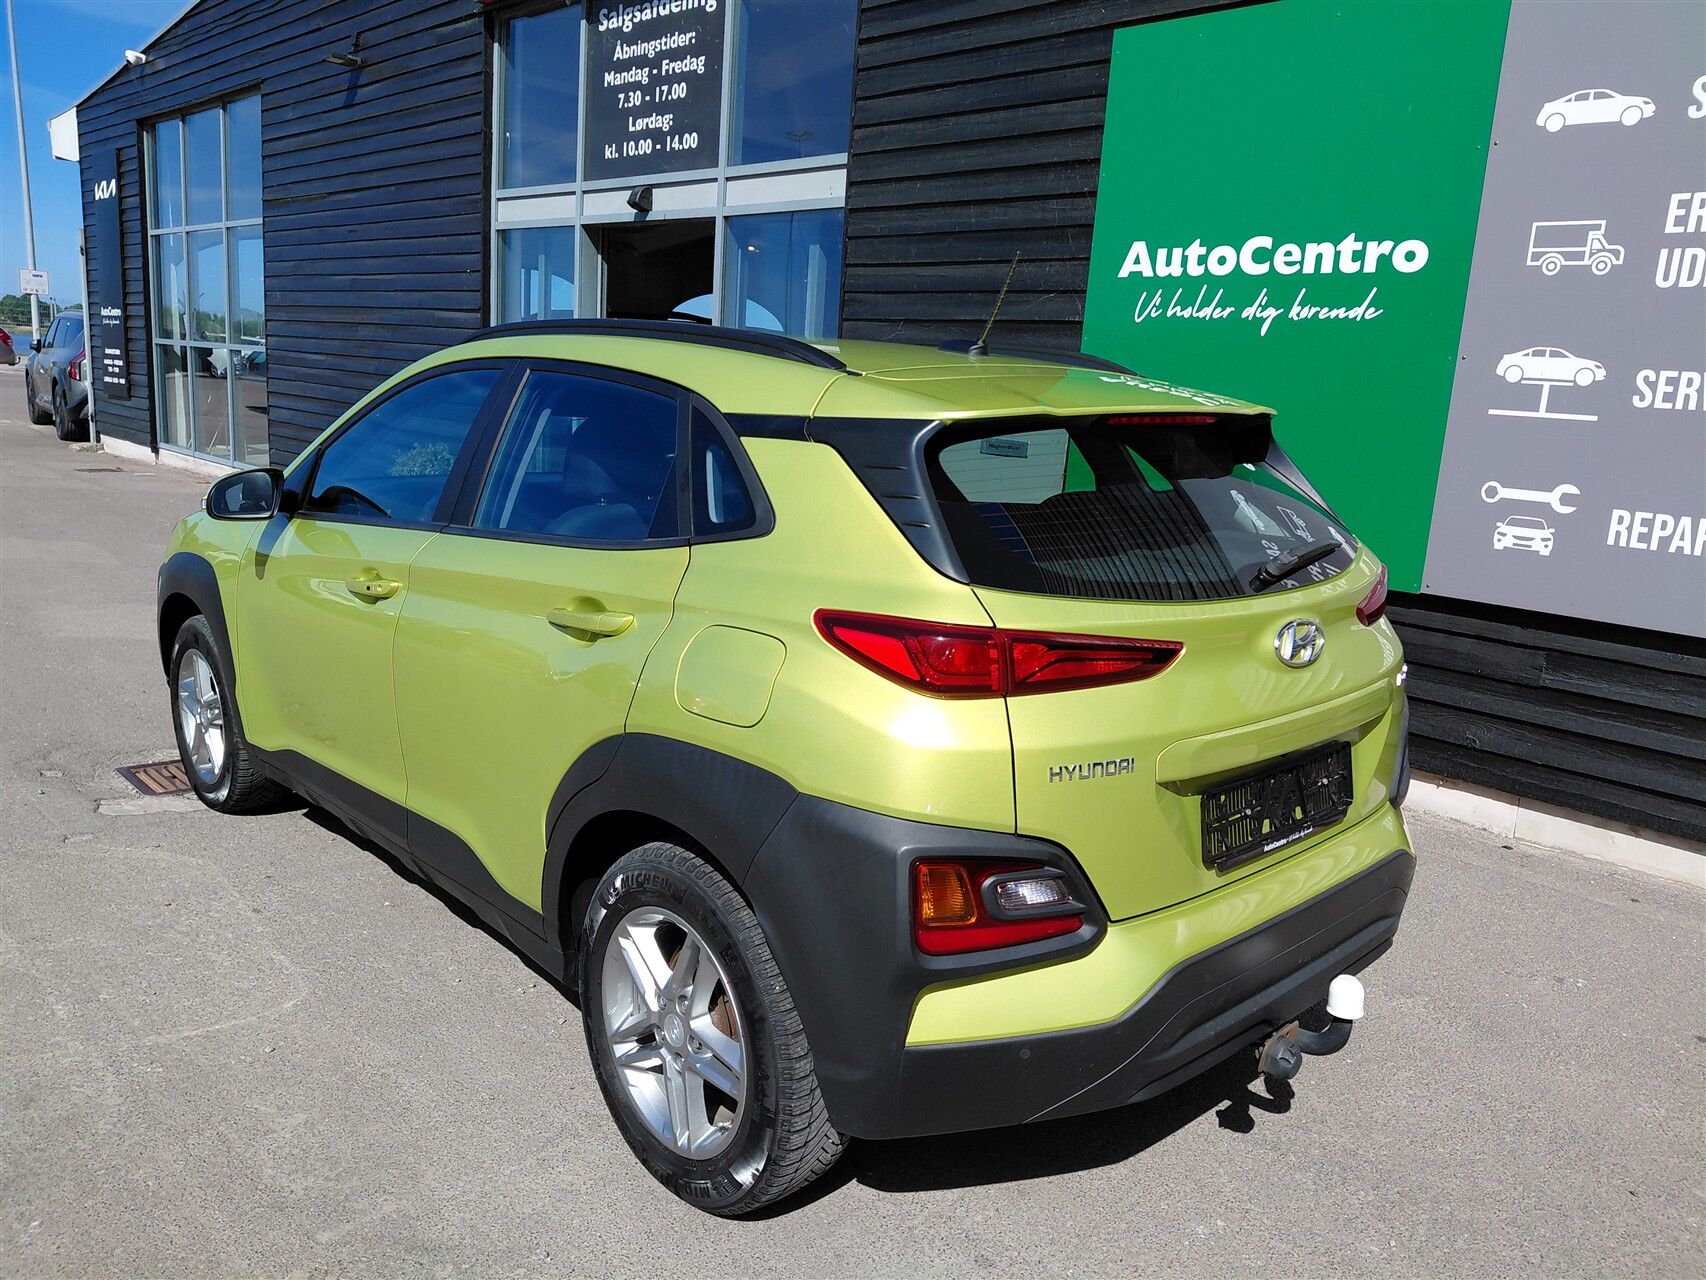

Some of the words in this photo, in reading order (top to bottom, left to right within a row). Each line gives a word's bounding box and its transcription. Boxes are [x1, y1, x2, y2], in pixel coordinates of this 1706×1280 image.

[613, 32, 696, 61] Åbningstider:
[604, 67, 650, 87] Mandag
[661, 55, 706, 76] Fredag
[617, 91, 642, 109] 7.30
[655, 82, 687, 103] 17.00
[628, 113, 674, 132] Lørdag:
[604, 144, 619, 159] kl.
[623, 138, 652, 157] 10.00
[666, 132, 698, 152] 14.00
[1117, 232, 1429, 278] AutoCentro
[1655, 247, 1706, 288] UD
[1134, 286, 1163, 323] Vi
[1166, 284, 1236, 321] holder
[1241, 287, 1284, 337] dig
[1288, 286, 1384, 321] kørende
[1632, 368, 1706, 411] SER
[1049, 758, 1135, 784] HYUNDAI
